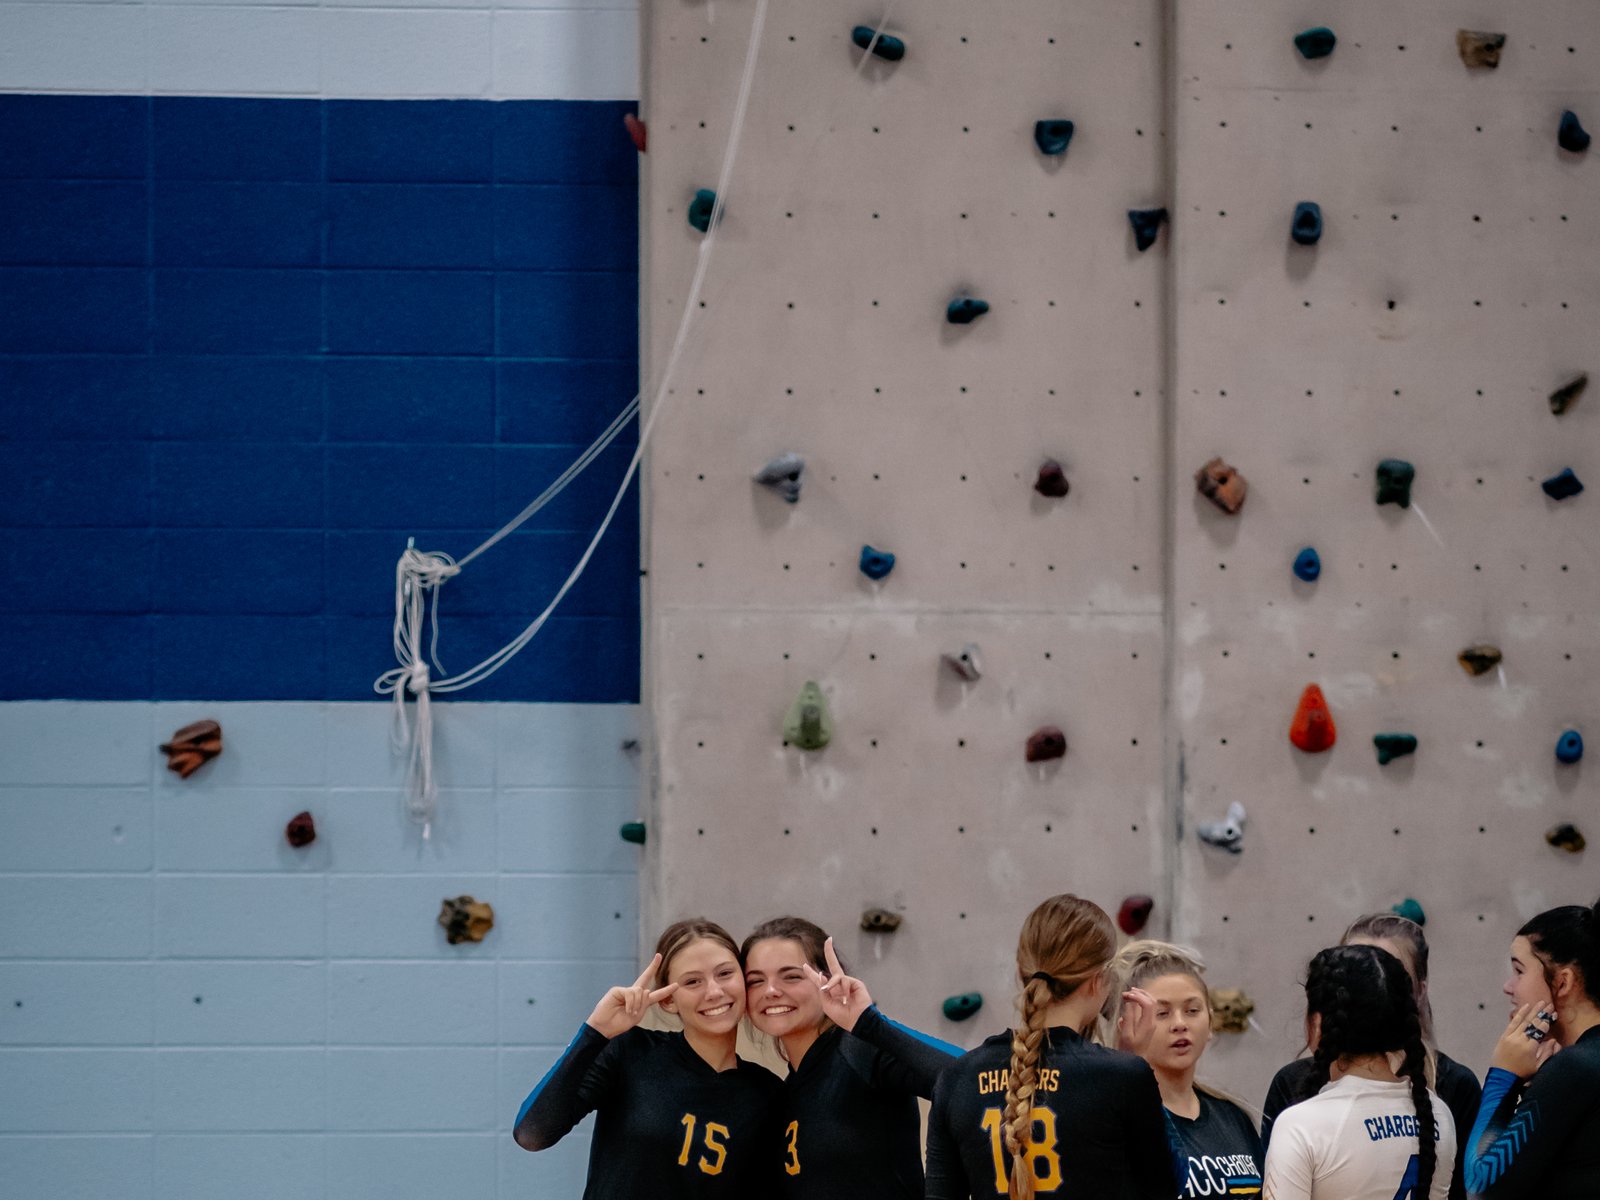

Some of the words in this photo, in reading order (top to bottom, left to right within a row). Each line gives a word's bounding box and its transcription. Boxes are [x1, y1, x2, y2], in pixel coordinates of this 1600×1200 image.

[978, 1068, 1060, 1094] CHARS
[678, 1112, 730, 1176] 15
[784, 1119, 801, 1176] 3
[980, 1105, 1063, 1194] 18
[1364, 1115, 1440, 1141] CHARGES
